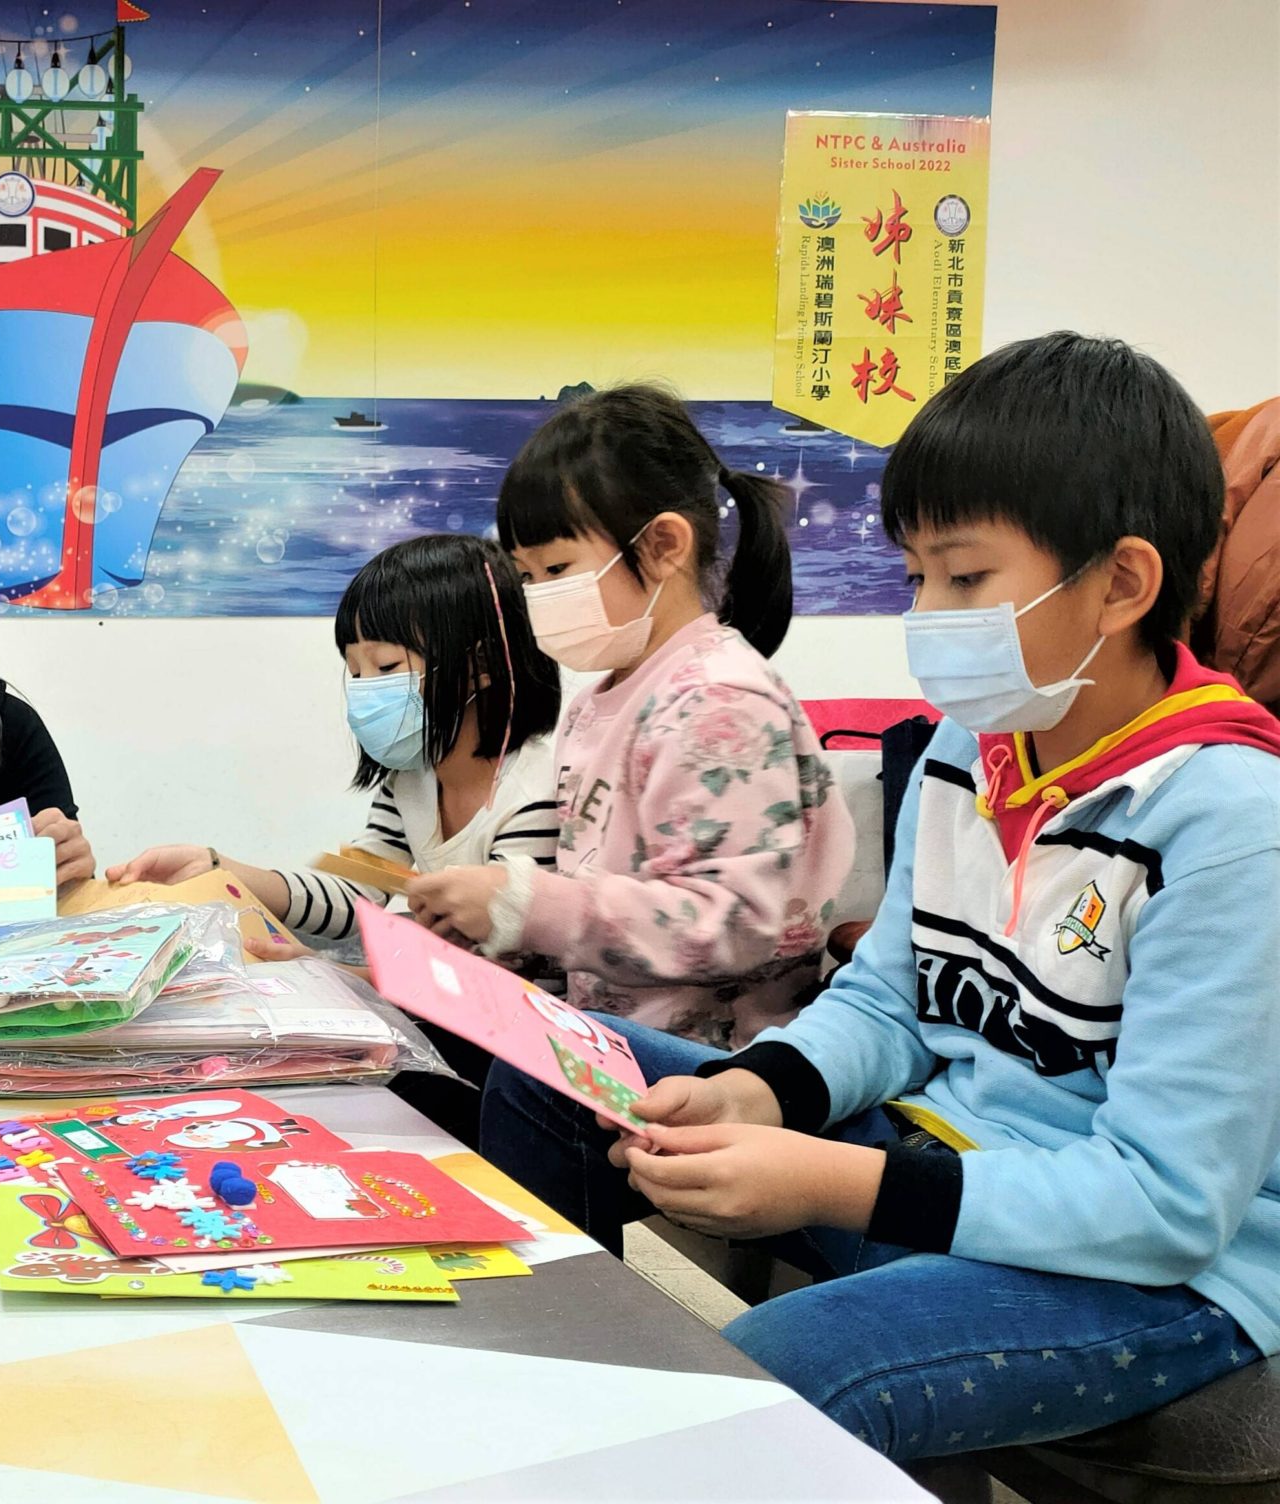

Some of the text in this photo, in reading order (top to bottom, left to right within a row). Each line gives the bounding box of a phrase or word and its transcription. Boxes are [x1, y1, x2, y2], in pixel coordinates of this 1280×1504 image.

[815, 133, 967, 154] NTPC & Australia
[830, 156, 951, 172] Sister School 2022
[793, 235, 811, 398] Rapids Landing Primary School
[811, 236, 835, 401] 澳洲瑞碧斯蘭汀小學
[851, 188, 917, 404] 姊妹校
[928, 239, 943, 400] Aodi Elementary Schoo
